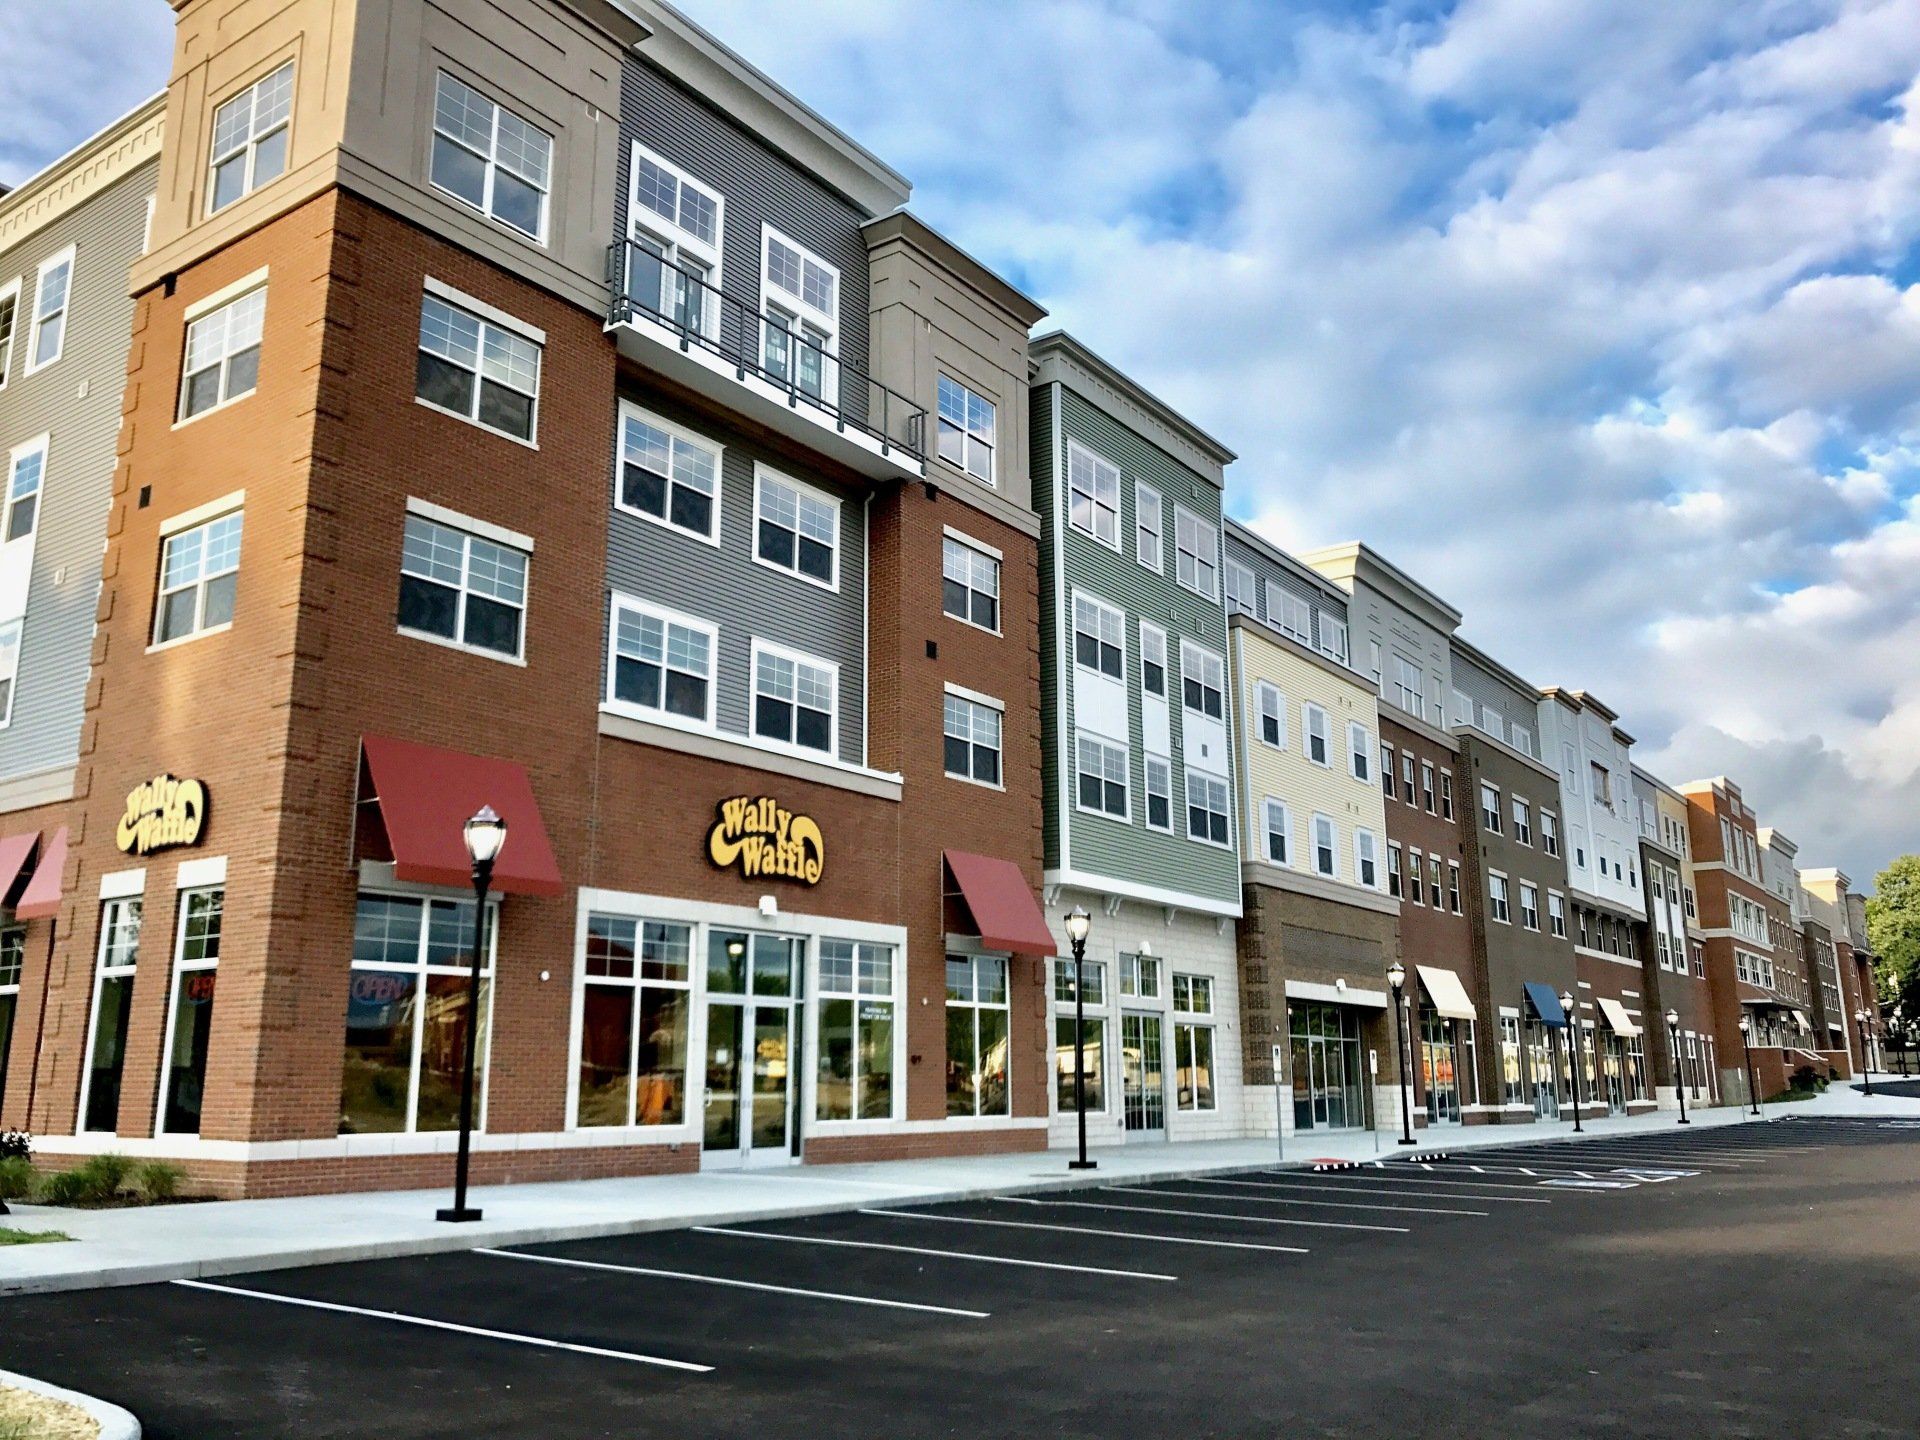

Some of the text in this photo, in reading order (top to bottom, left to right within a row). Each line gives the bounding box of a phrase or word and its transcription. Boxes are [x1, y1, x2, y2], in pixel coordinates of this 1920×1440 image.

[127, 774, 180, 826] Wally
[722, 797, 792, 841] Wally
[117, 800, 203, 854] Waffle
[711, 819, 824, 884] Waffle
[353, 975, 404, 1000] OPEN
